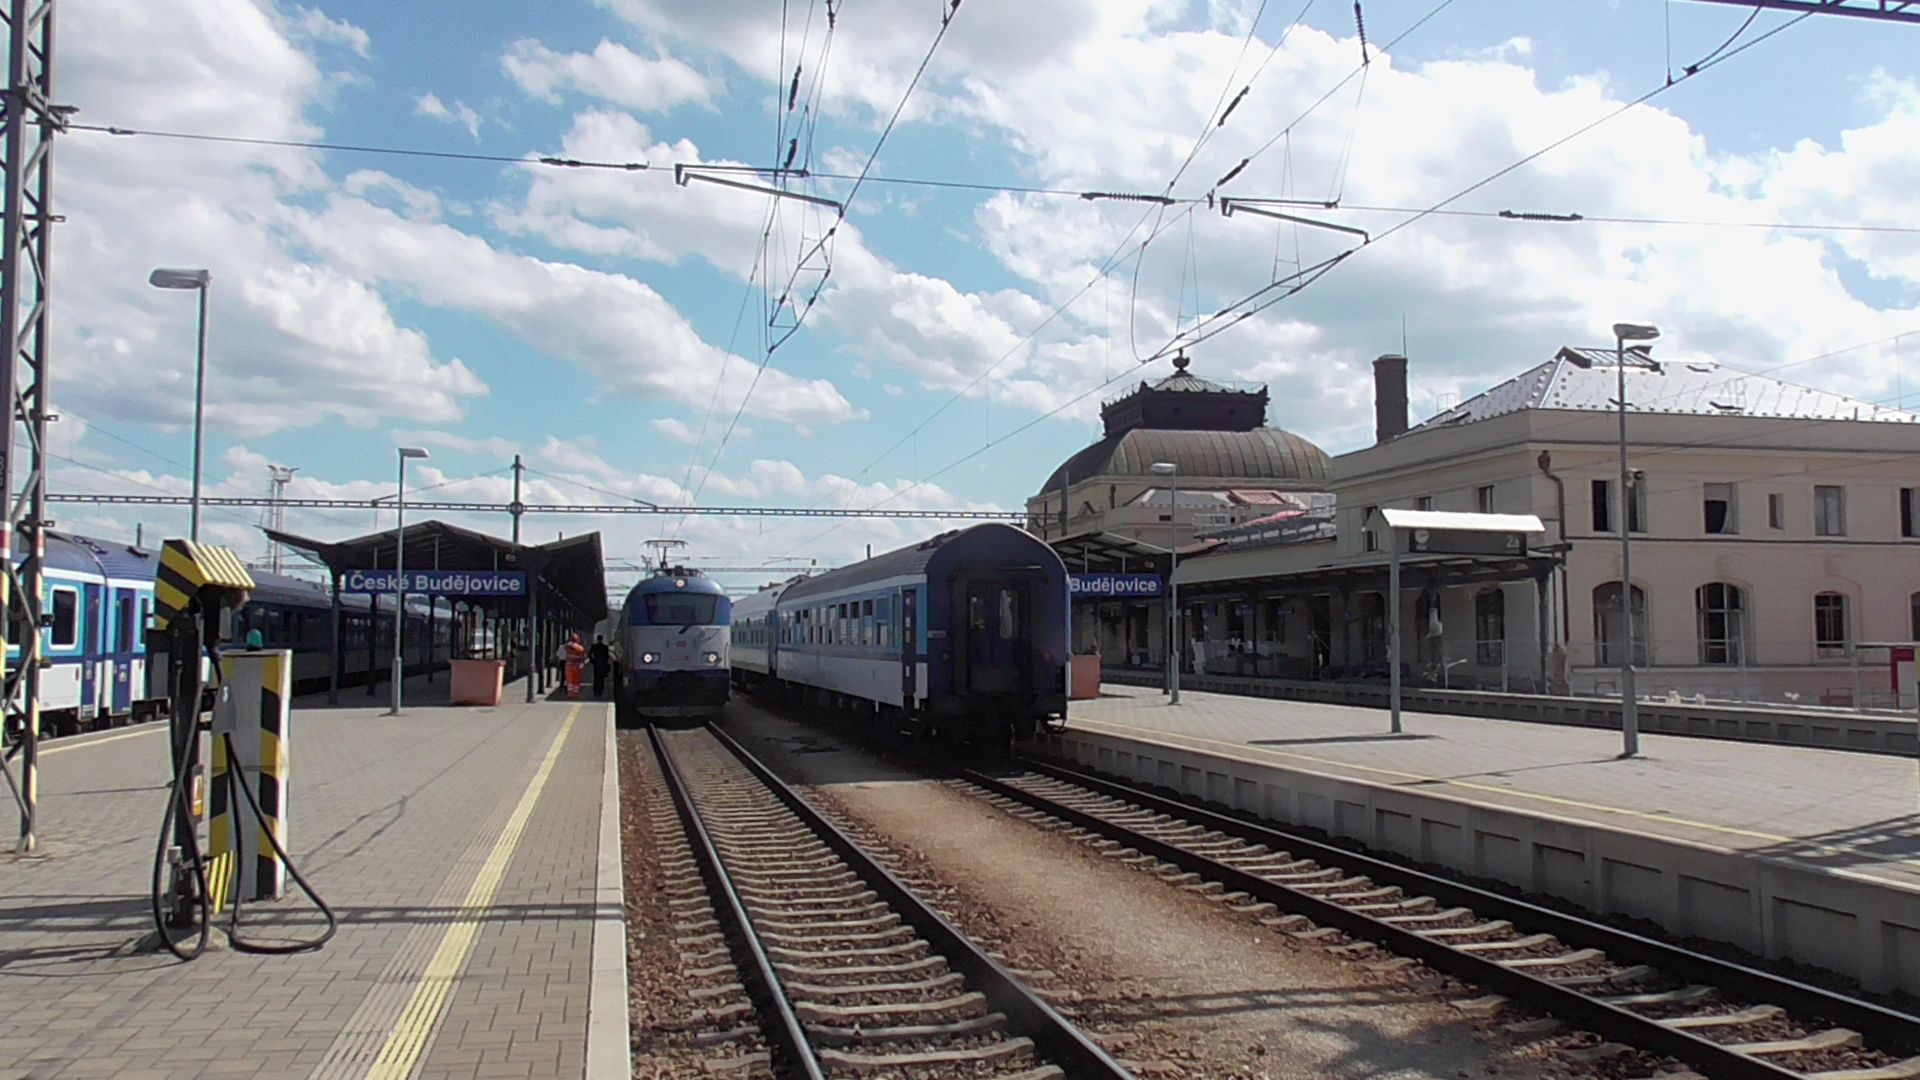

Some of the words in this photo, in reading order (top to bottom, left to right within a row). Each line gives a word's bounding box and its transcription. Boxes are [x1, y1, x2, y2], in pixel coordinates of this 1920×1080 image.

[350, 570, 409, 591] České
[415, 574, 521, 595] Budějovice
[1069, 577, 1157, 596] Budějovice
